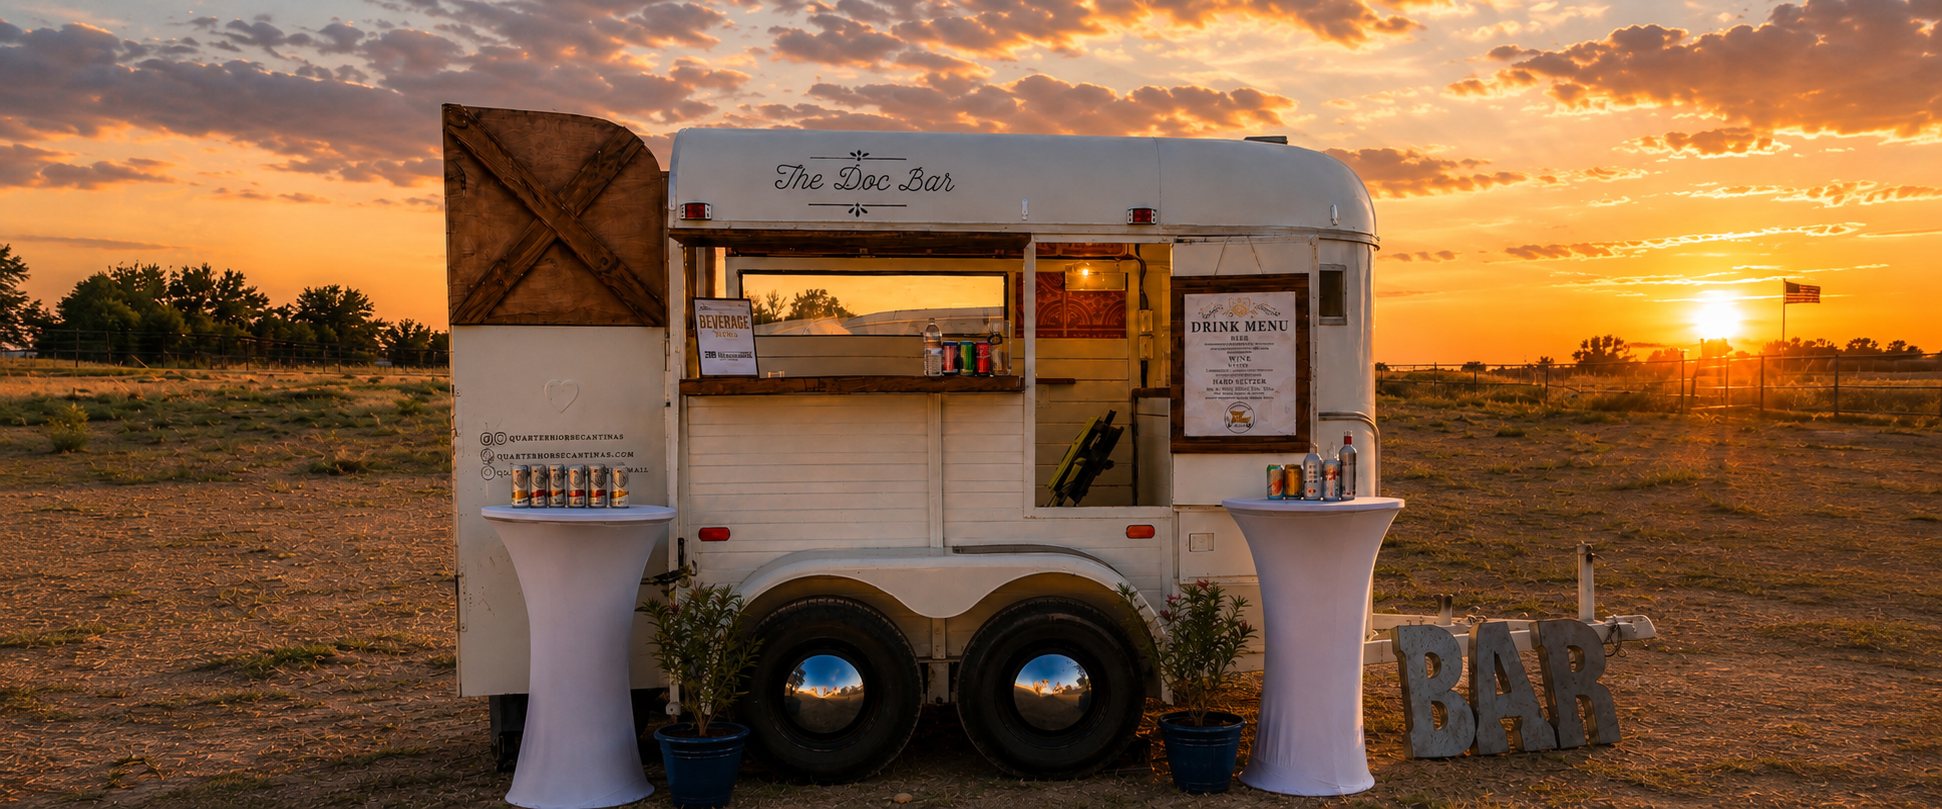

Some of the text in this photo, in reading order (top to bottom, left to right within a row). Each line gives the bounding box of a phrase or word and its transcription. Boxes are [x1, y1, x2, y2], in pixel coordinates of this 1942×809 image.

[774, 164, 955, 192] The Doc Bar
[699, 314, 750, 330] BEVERAGE
[1191, 320, 1289, 333] DRINK MENU
[1390, 619, 1622, 759] BAR
